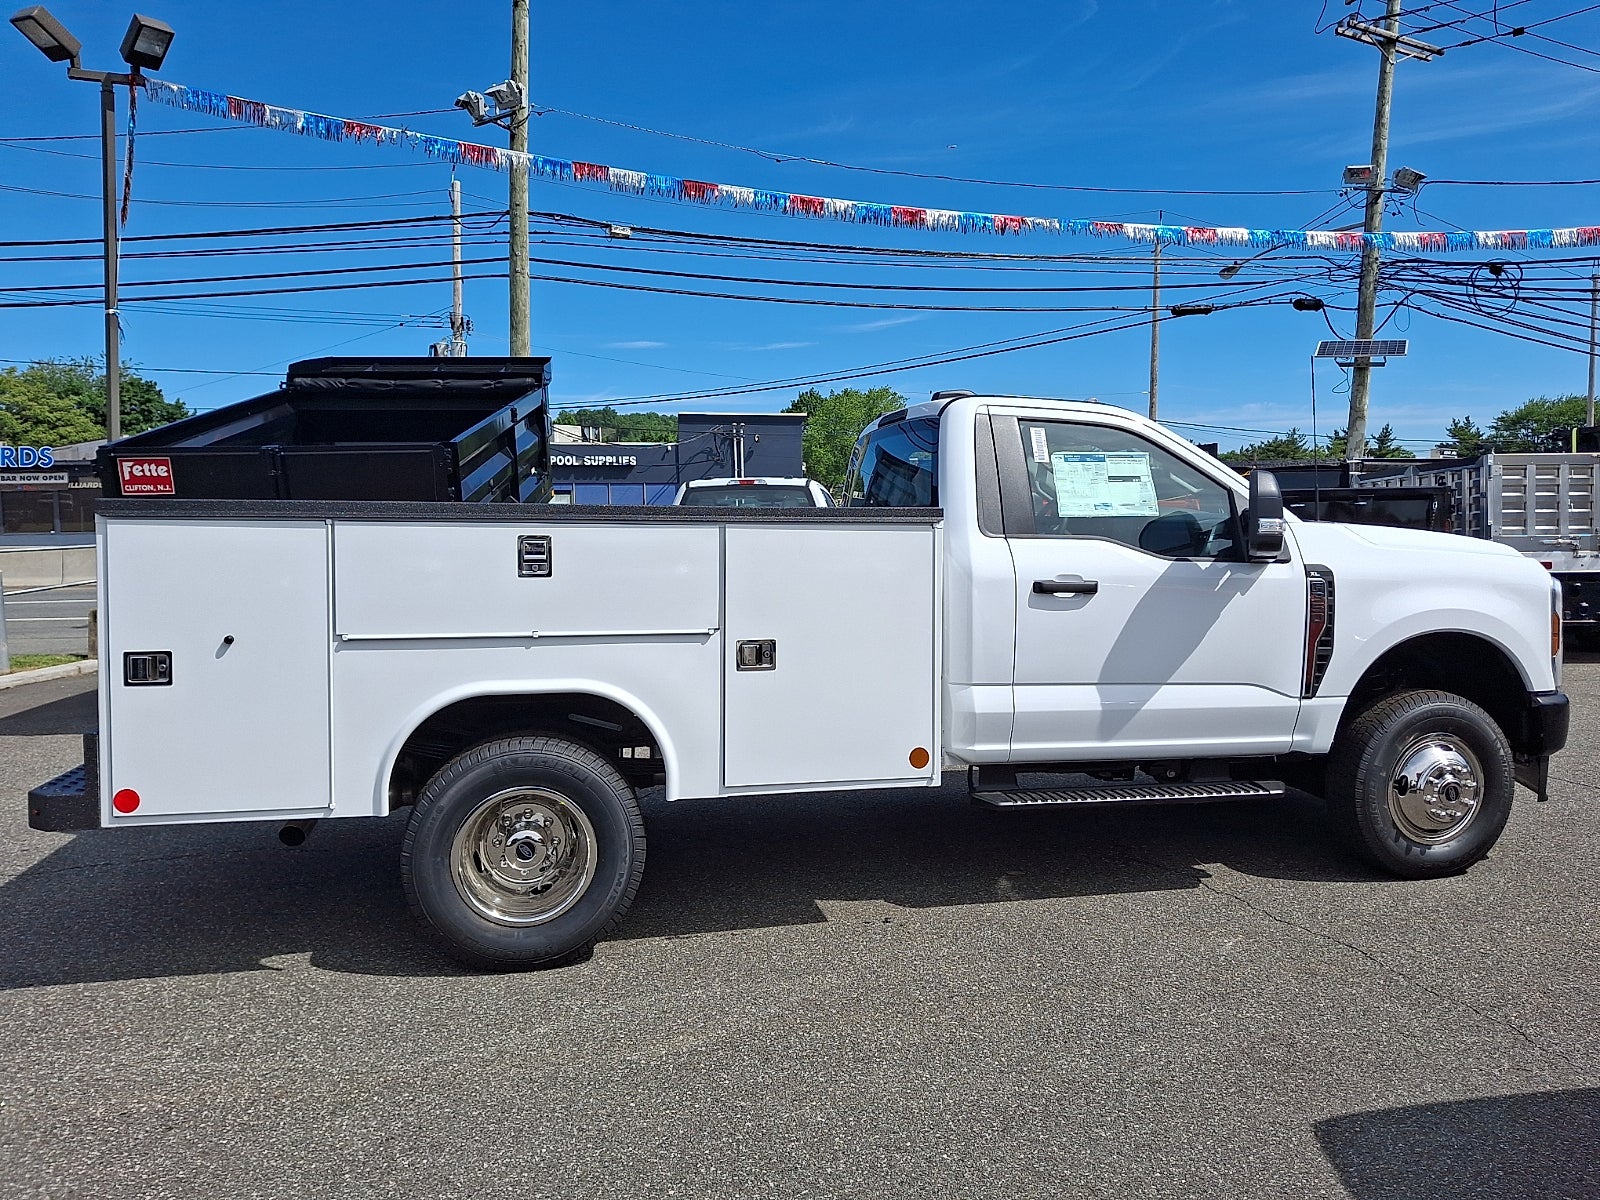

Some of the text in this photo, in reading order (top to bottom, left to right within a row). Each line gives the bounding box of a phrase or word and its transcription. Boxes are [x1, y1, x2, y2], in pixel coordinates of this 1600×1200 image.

[0, 446, 54, 468] RDS
[550, 455, 637, 466] POOL SUPPLIES
[122, 461, 169, 480] Fette
